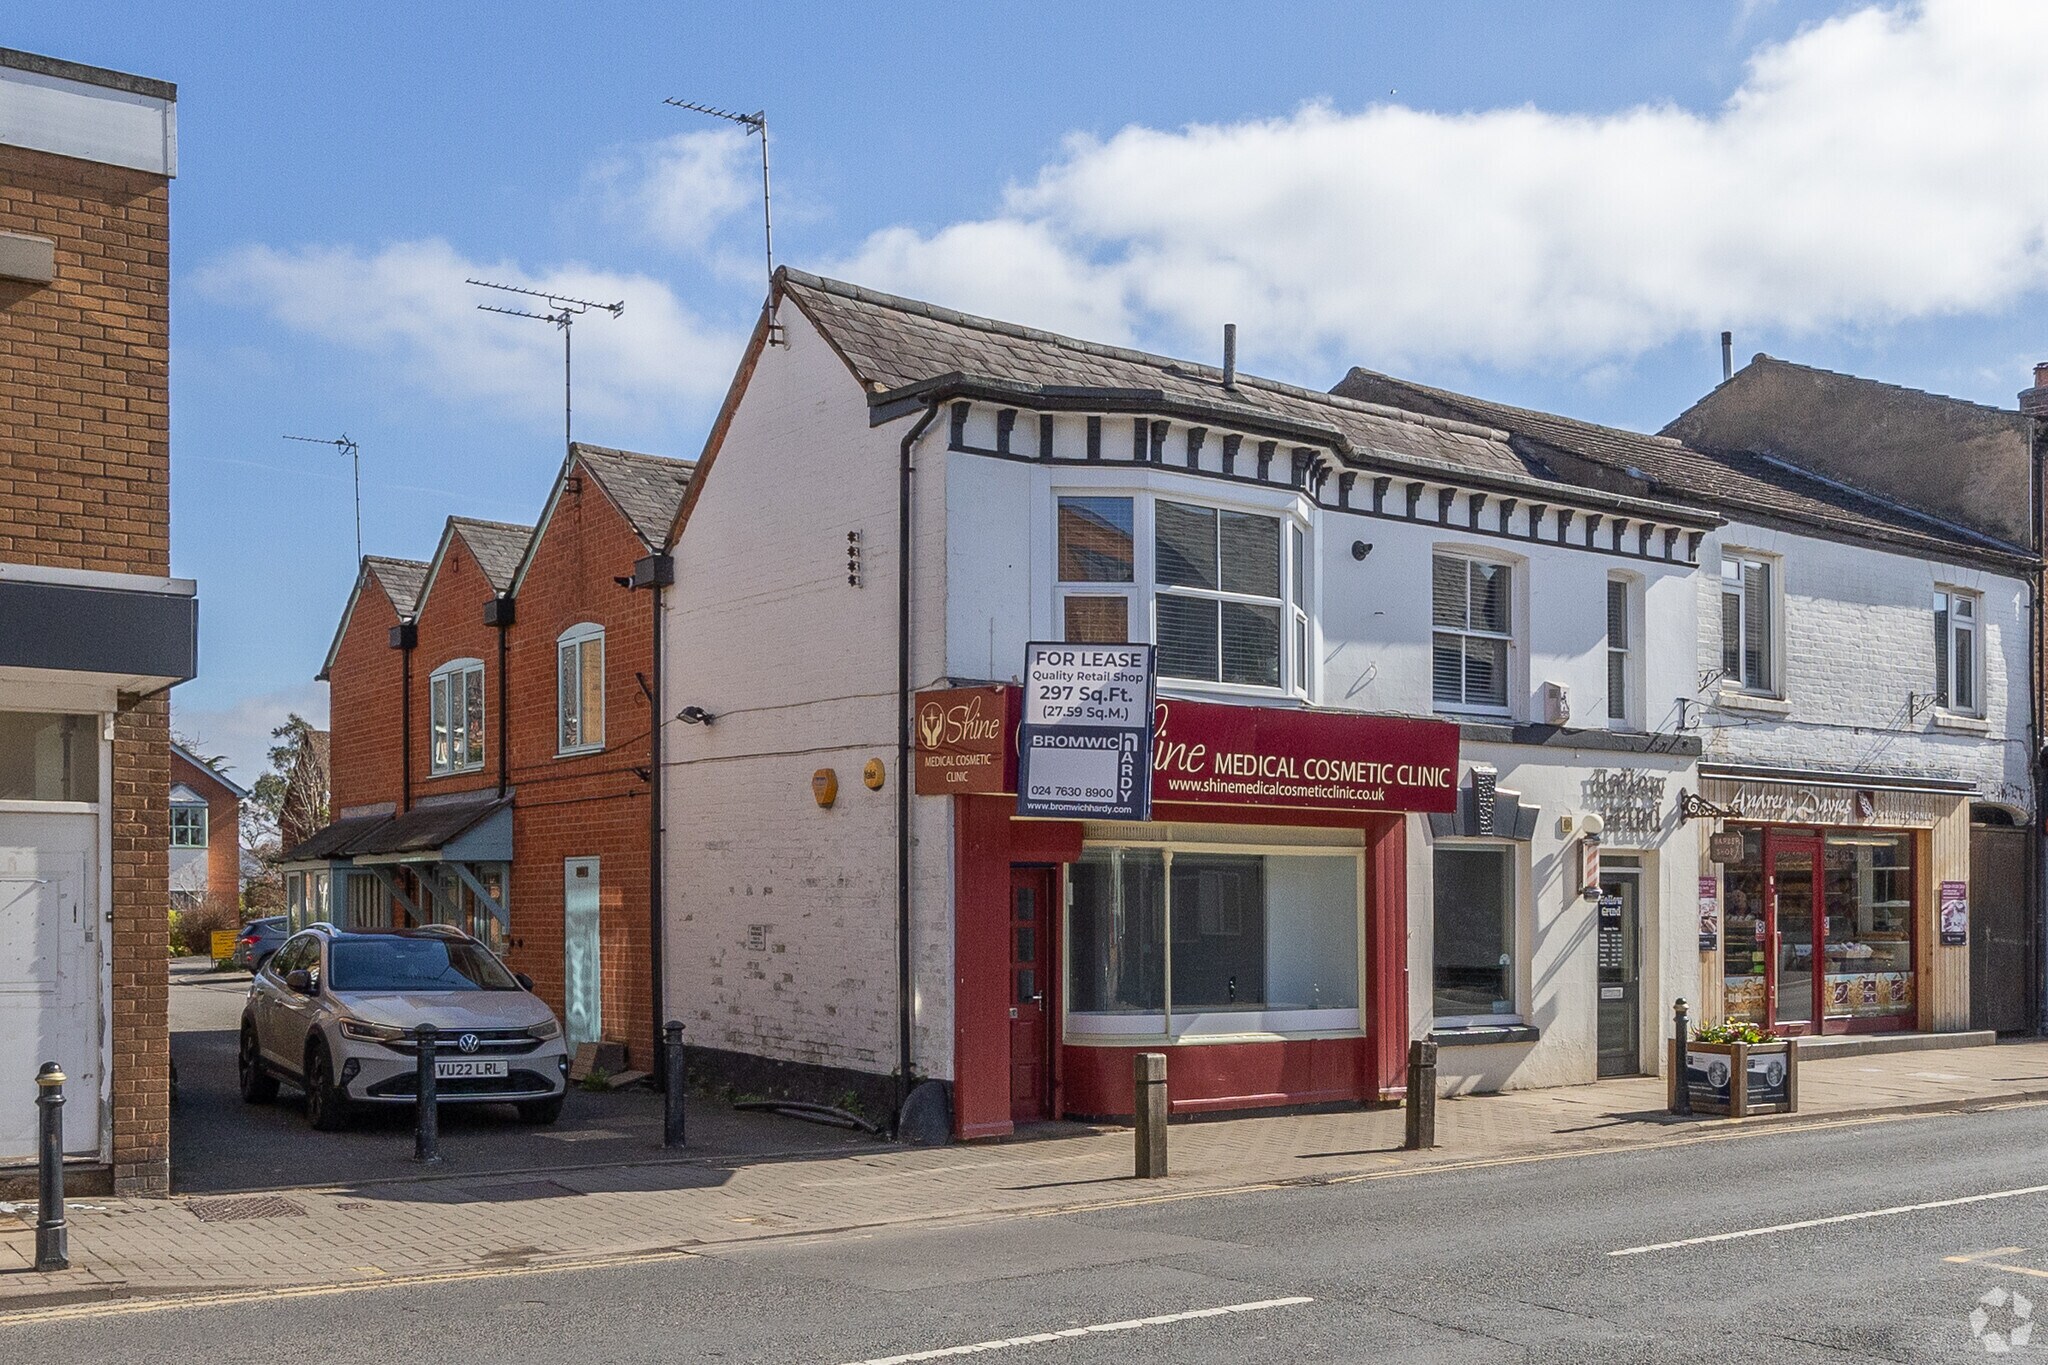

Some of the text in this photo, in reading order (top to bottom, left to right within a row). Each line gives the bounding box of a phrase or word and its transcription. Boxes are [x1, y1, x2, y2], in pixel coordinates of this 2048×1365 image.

[1036, 651, 1142, 668] FOR LEASE
[1032, 670, 1144, 684] Quality Retail Shop
[1040, 685, 1133, 705] 297 Sq.Ft.
[946, 695, 1000, 744] Shine
[1043, 705, 1129, 721] (27.59 Sq.M.)
[924, 753, 992, 767] MEDICAL COSMETIC
[946, 771, 969, 783] CLINIC
[1215, 752, 1300, 780] MEDICAL
[1303, 758, 1394, 785] COSMETIC
[1396, 765, 1451, 789] CLINIC
[1031, 785, 1114, 798] 024 7630 8900
[1169, 777, 1385, 801] www.shinemedicalcosmeticclinic.co.uk
[1027, 802, 1132, 815] www.bromwichhardy.com
[437, 1062, 501, 1076] VU22 LRL
